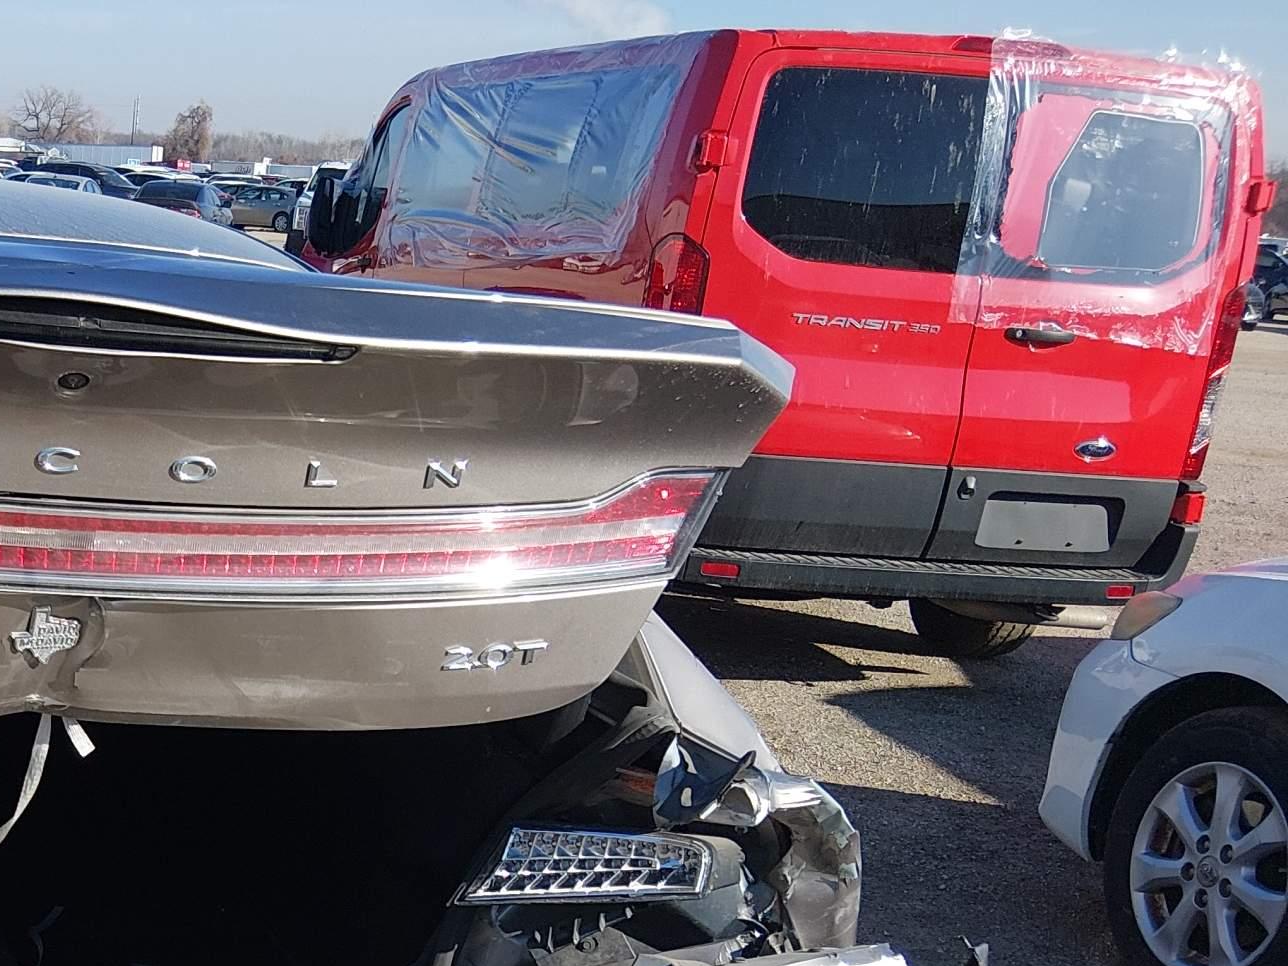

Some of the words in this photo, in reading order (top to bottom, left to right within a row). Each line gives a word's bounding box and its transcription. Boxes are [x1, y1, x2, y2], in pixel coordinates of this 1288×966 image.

[791, 312, 907, 333] TRANSIT
[907, 323, 942, 336] 350
[38, 623, 79, 637] DAVID
[440, 638, 550, 672] 2.0T
